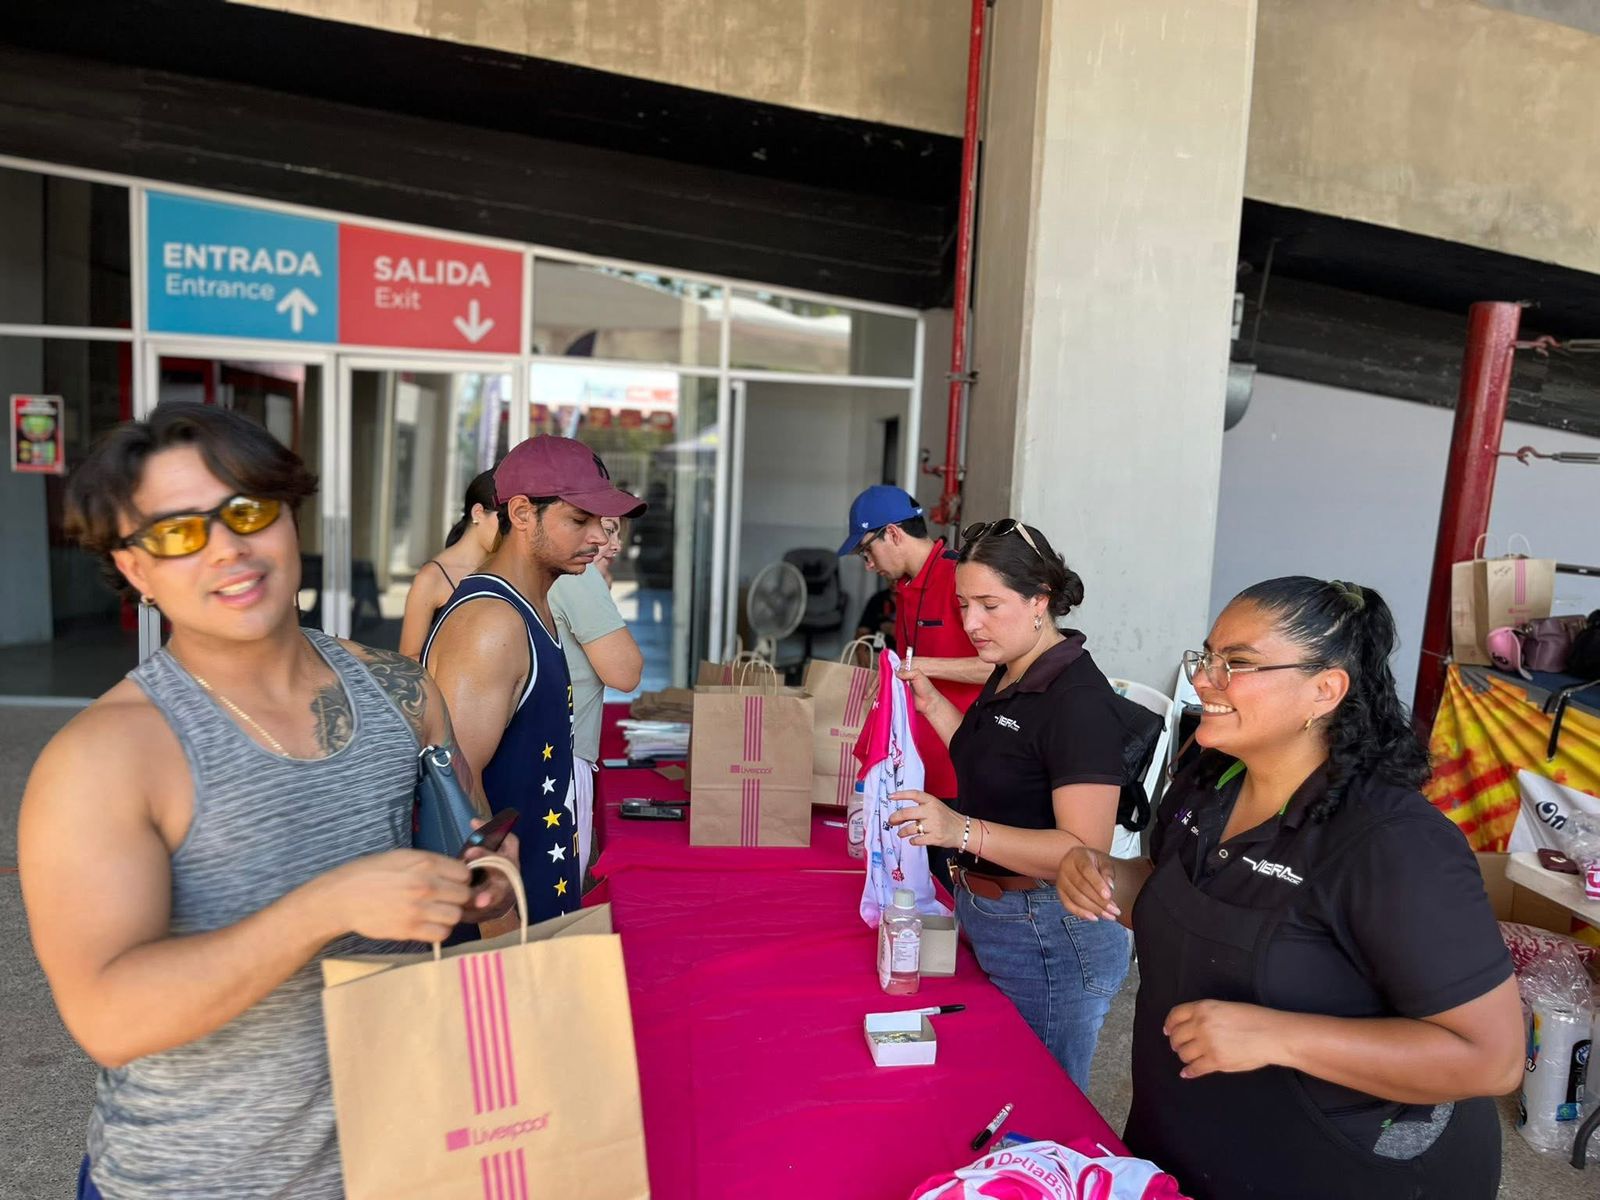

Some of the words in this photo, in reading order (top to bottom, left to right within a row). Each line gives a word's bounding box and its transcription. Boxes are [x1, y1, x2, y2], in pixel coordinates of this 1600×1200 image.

[163, 242, 322, 277] ENTRADA
[374, 255, 491, 288] SALIDA
[165, 273, 275, 300] Entrance
[374, 286, 421, 311] Exit
[1242, 856, 1303, 881] VIERA
[473, 1112, 550, 1146] Liverpool
